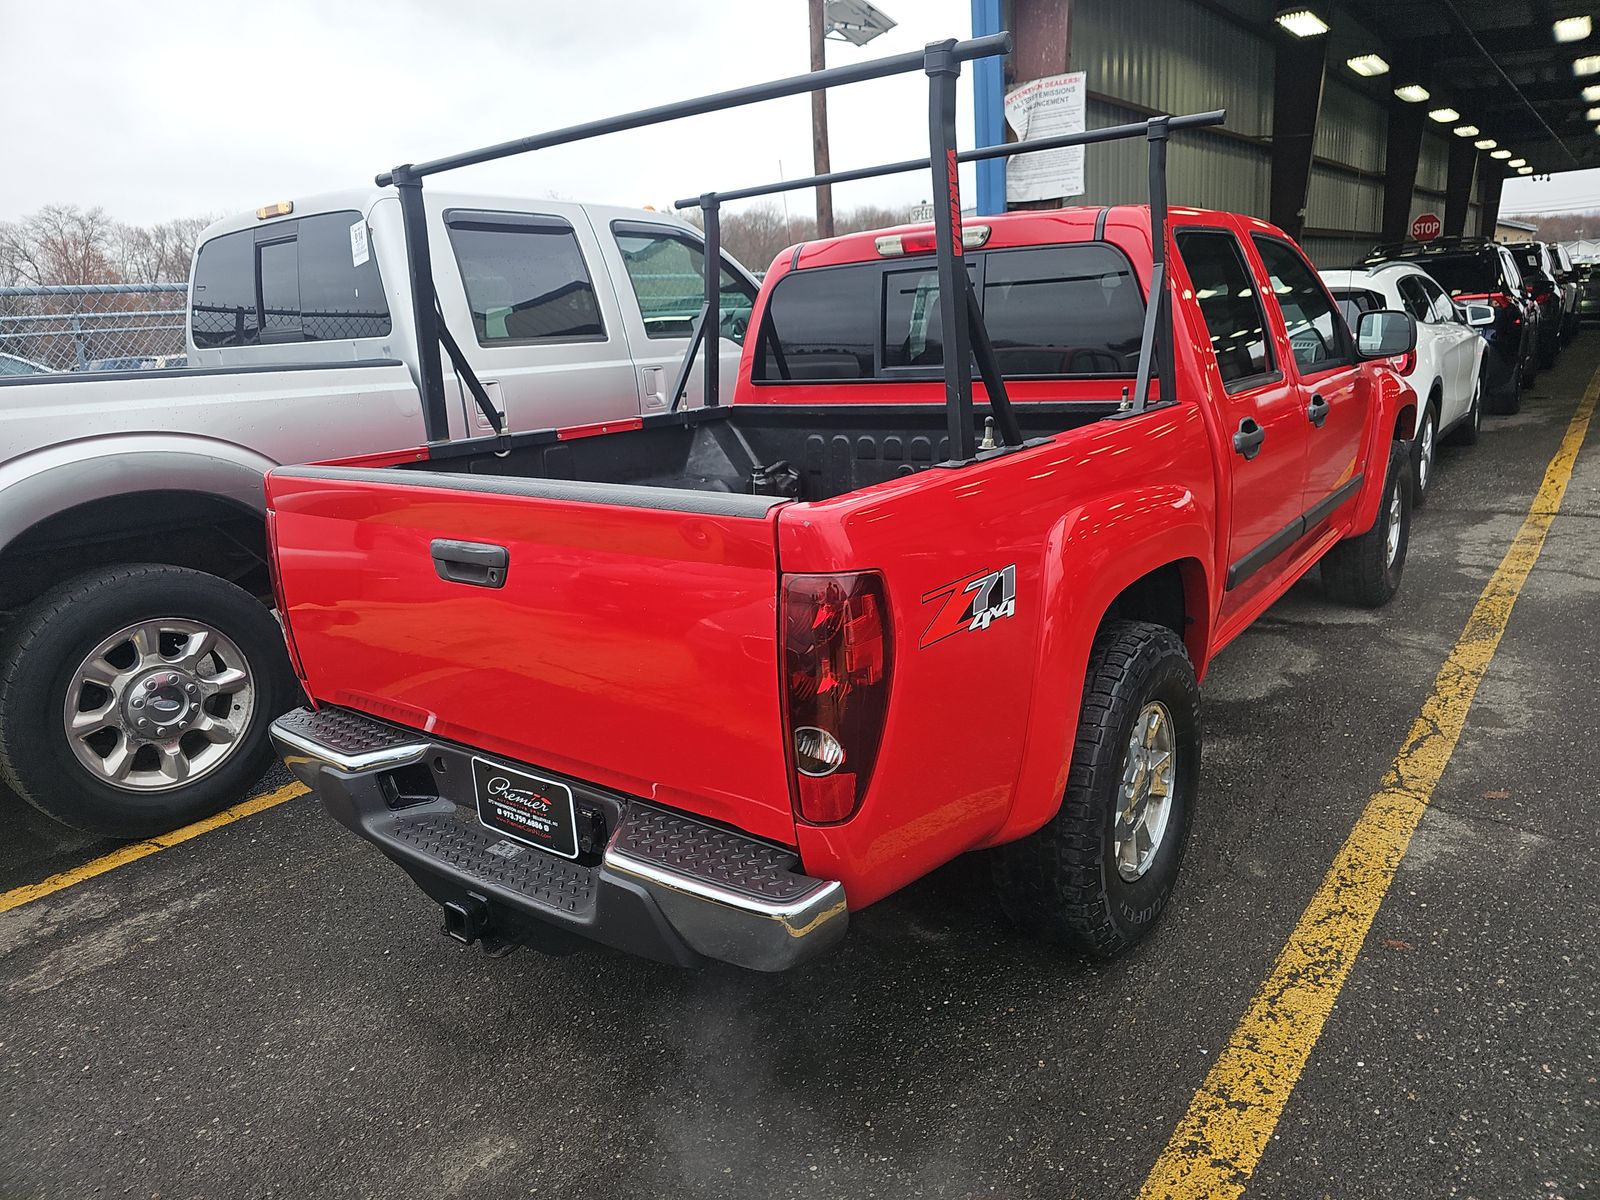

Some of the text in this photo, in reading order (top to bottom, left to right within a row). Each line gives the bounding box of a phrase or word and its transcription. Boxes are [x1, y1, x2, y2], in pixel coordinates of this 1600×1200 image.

[947, 149, 962, 257] YAKIMA
[1413, 221, 1440, 236] STOP
[487, 776, 549, 812] Premier
